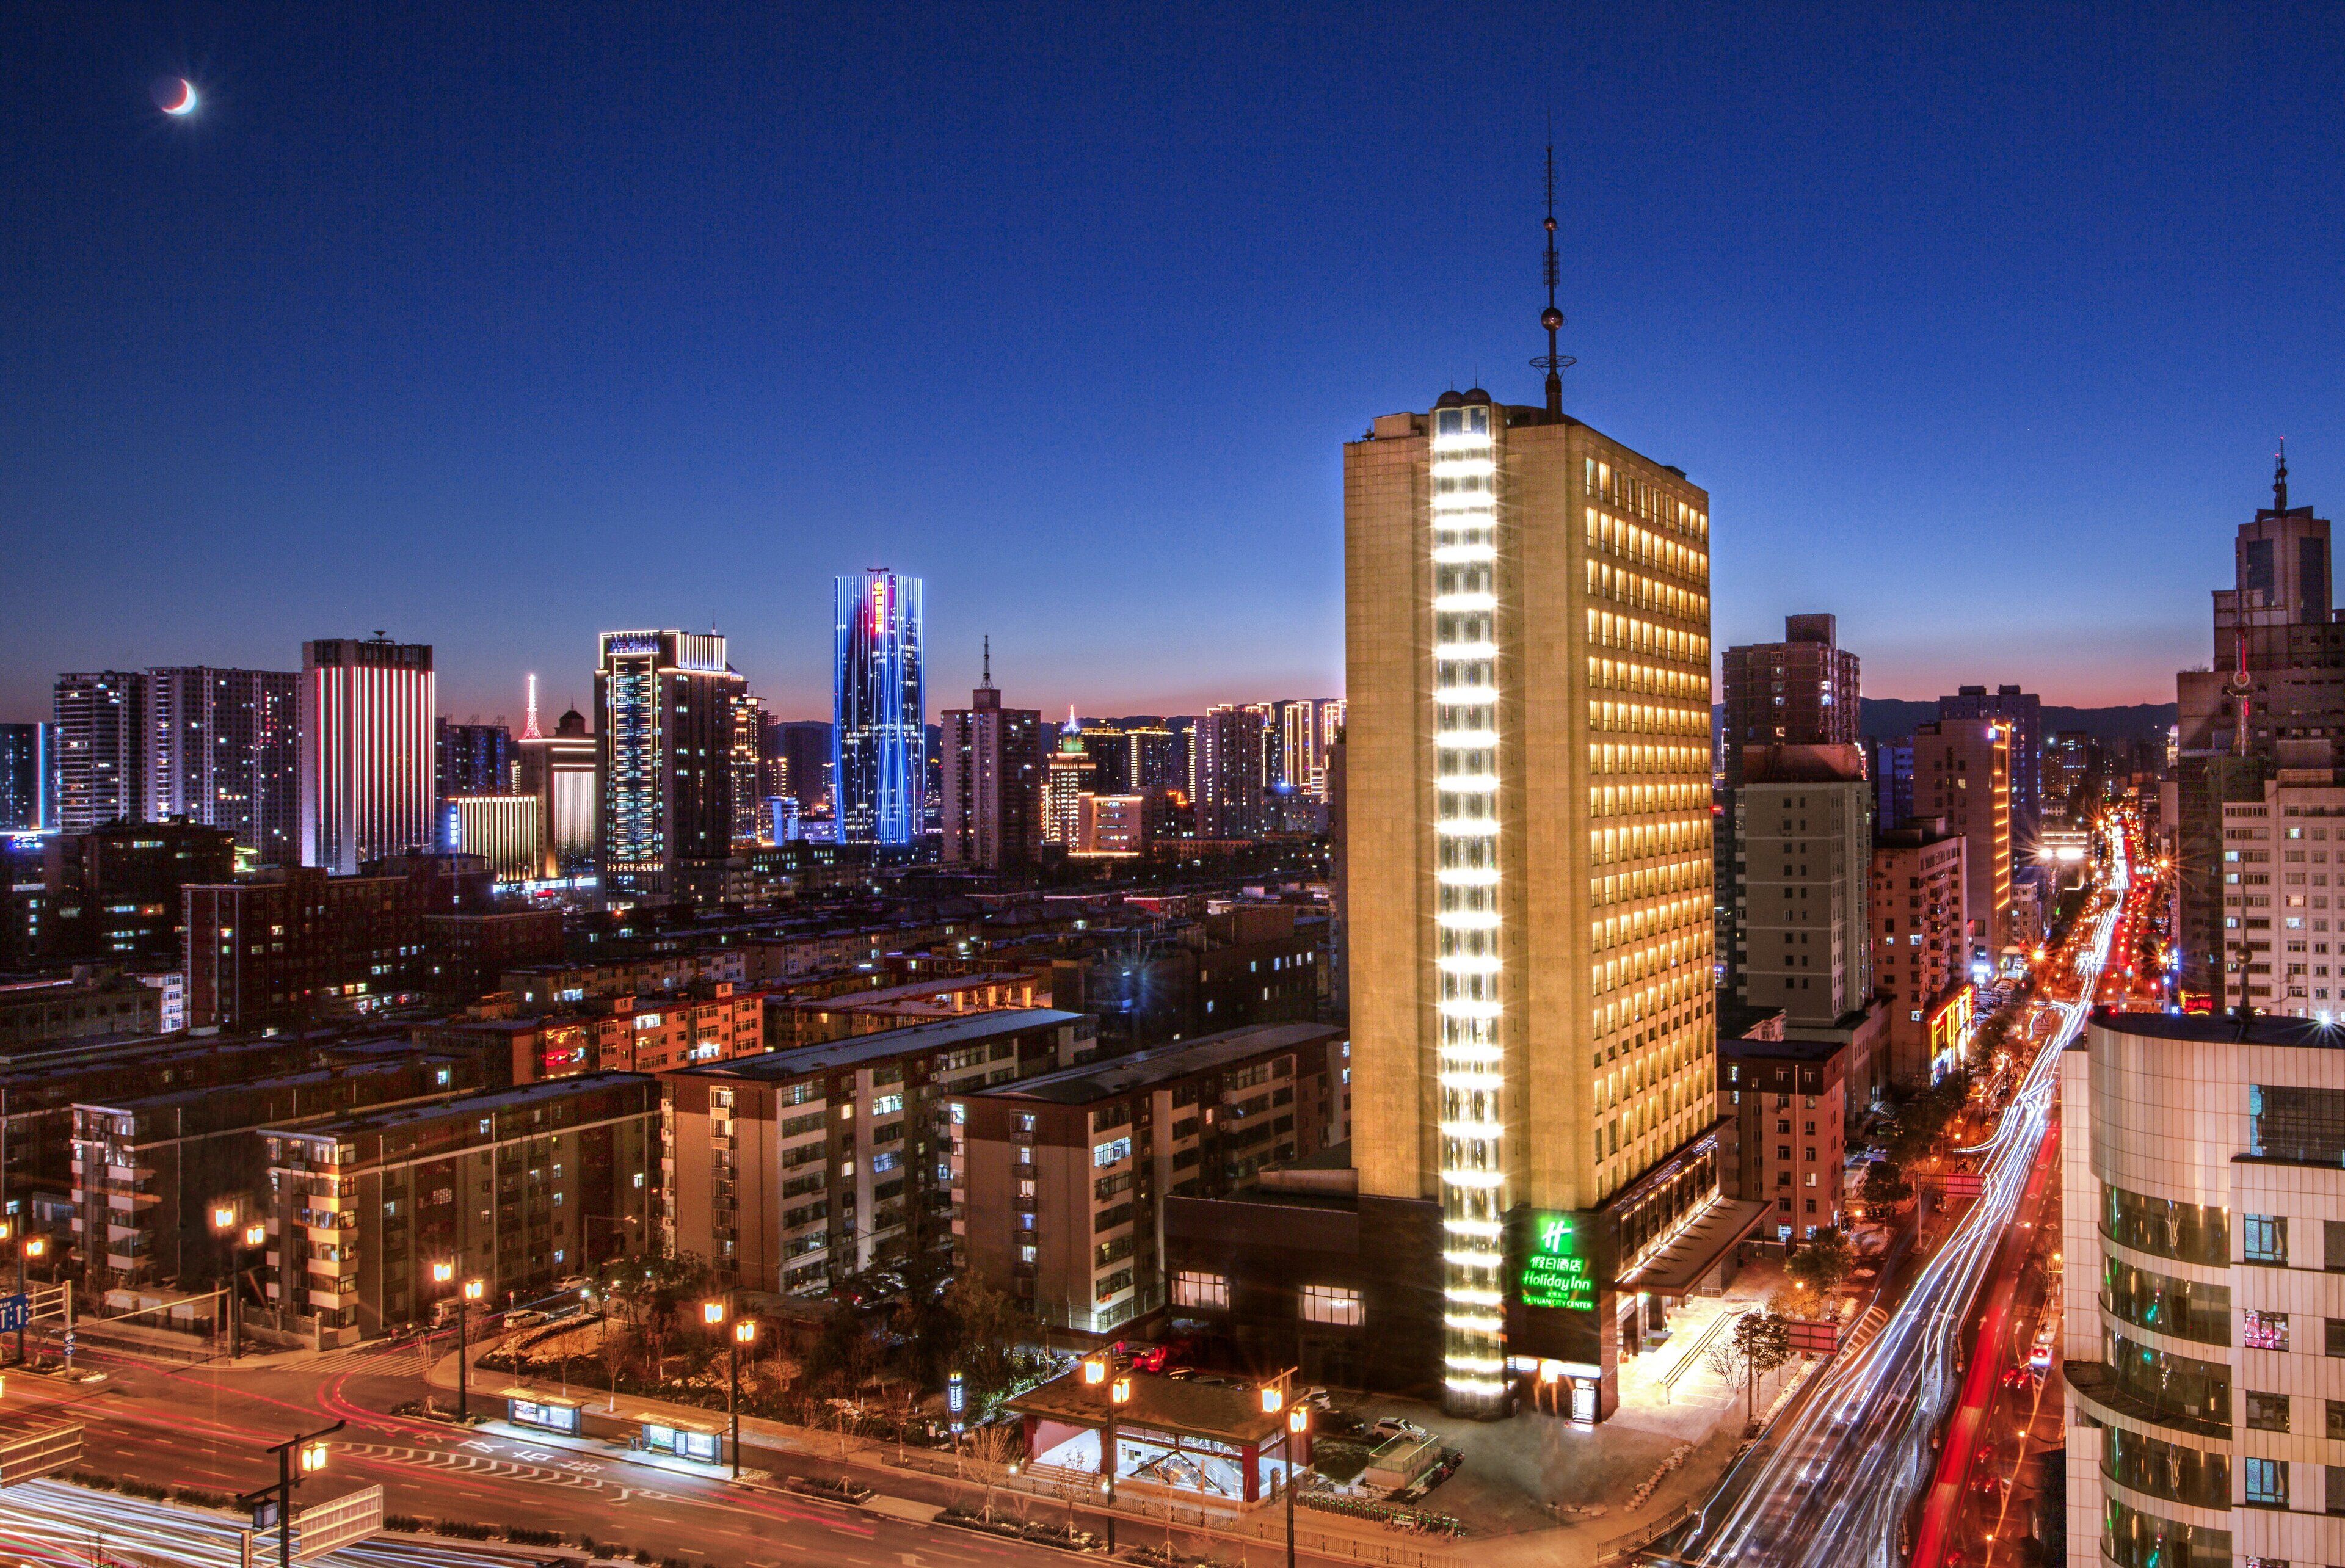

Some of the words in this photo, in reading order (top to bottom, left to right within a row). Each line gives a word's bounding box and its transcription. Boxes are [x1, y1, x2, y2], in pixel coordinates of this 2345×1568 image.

[1530, 1255, 1583, 1272] 假日酒店
[1522, 1271, 1569, 1291] Holiday
[1571, 1274, 1590, 1290] Inn
[1523, 1296, 1551, 1305] TAIYUAN
[1566, 1300, 1593, 1310] CENTER
